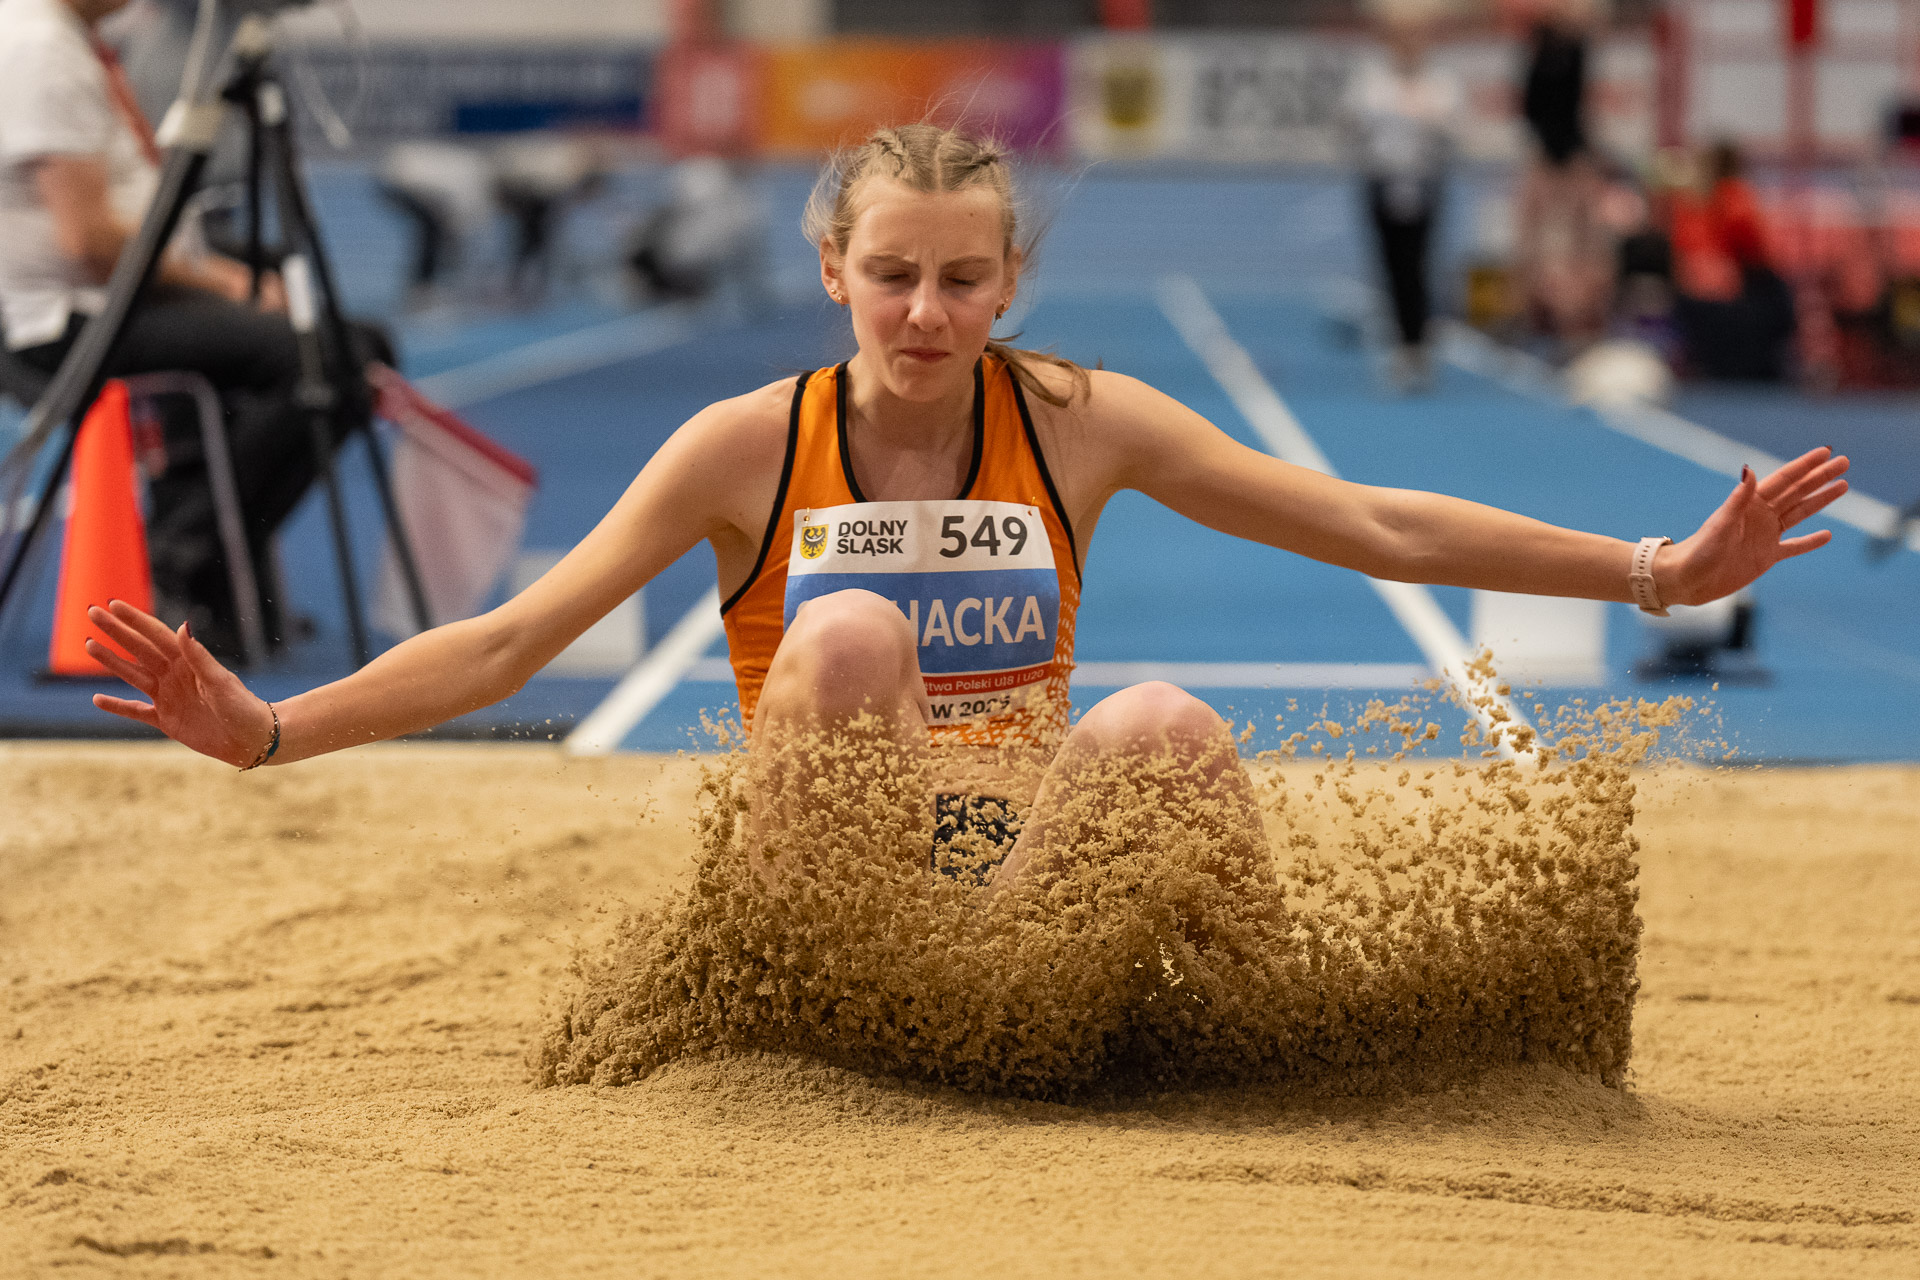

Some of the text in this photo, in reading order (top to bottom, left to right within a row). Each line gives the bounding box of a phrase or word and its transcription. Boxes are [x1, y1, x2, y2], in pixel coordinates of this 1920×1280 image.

[838, 519, 909, 537] DOLNY
[938, 514, 1029, 559] 549
[836, 533, 905, 557] ŚLĄSK
[955, 677, 993, 692] Polski
[994, 675, 1015, 688] U18
[1023, 668, 1045, 683] U20
